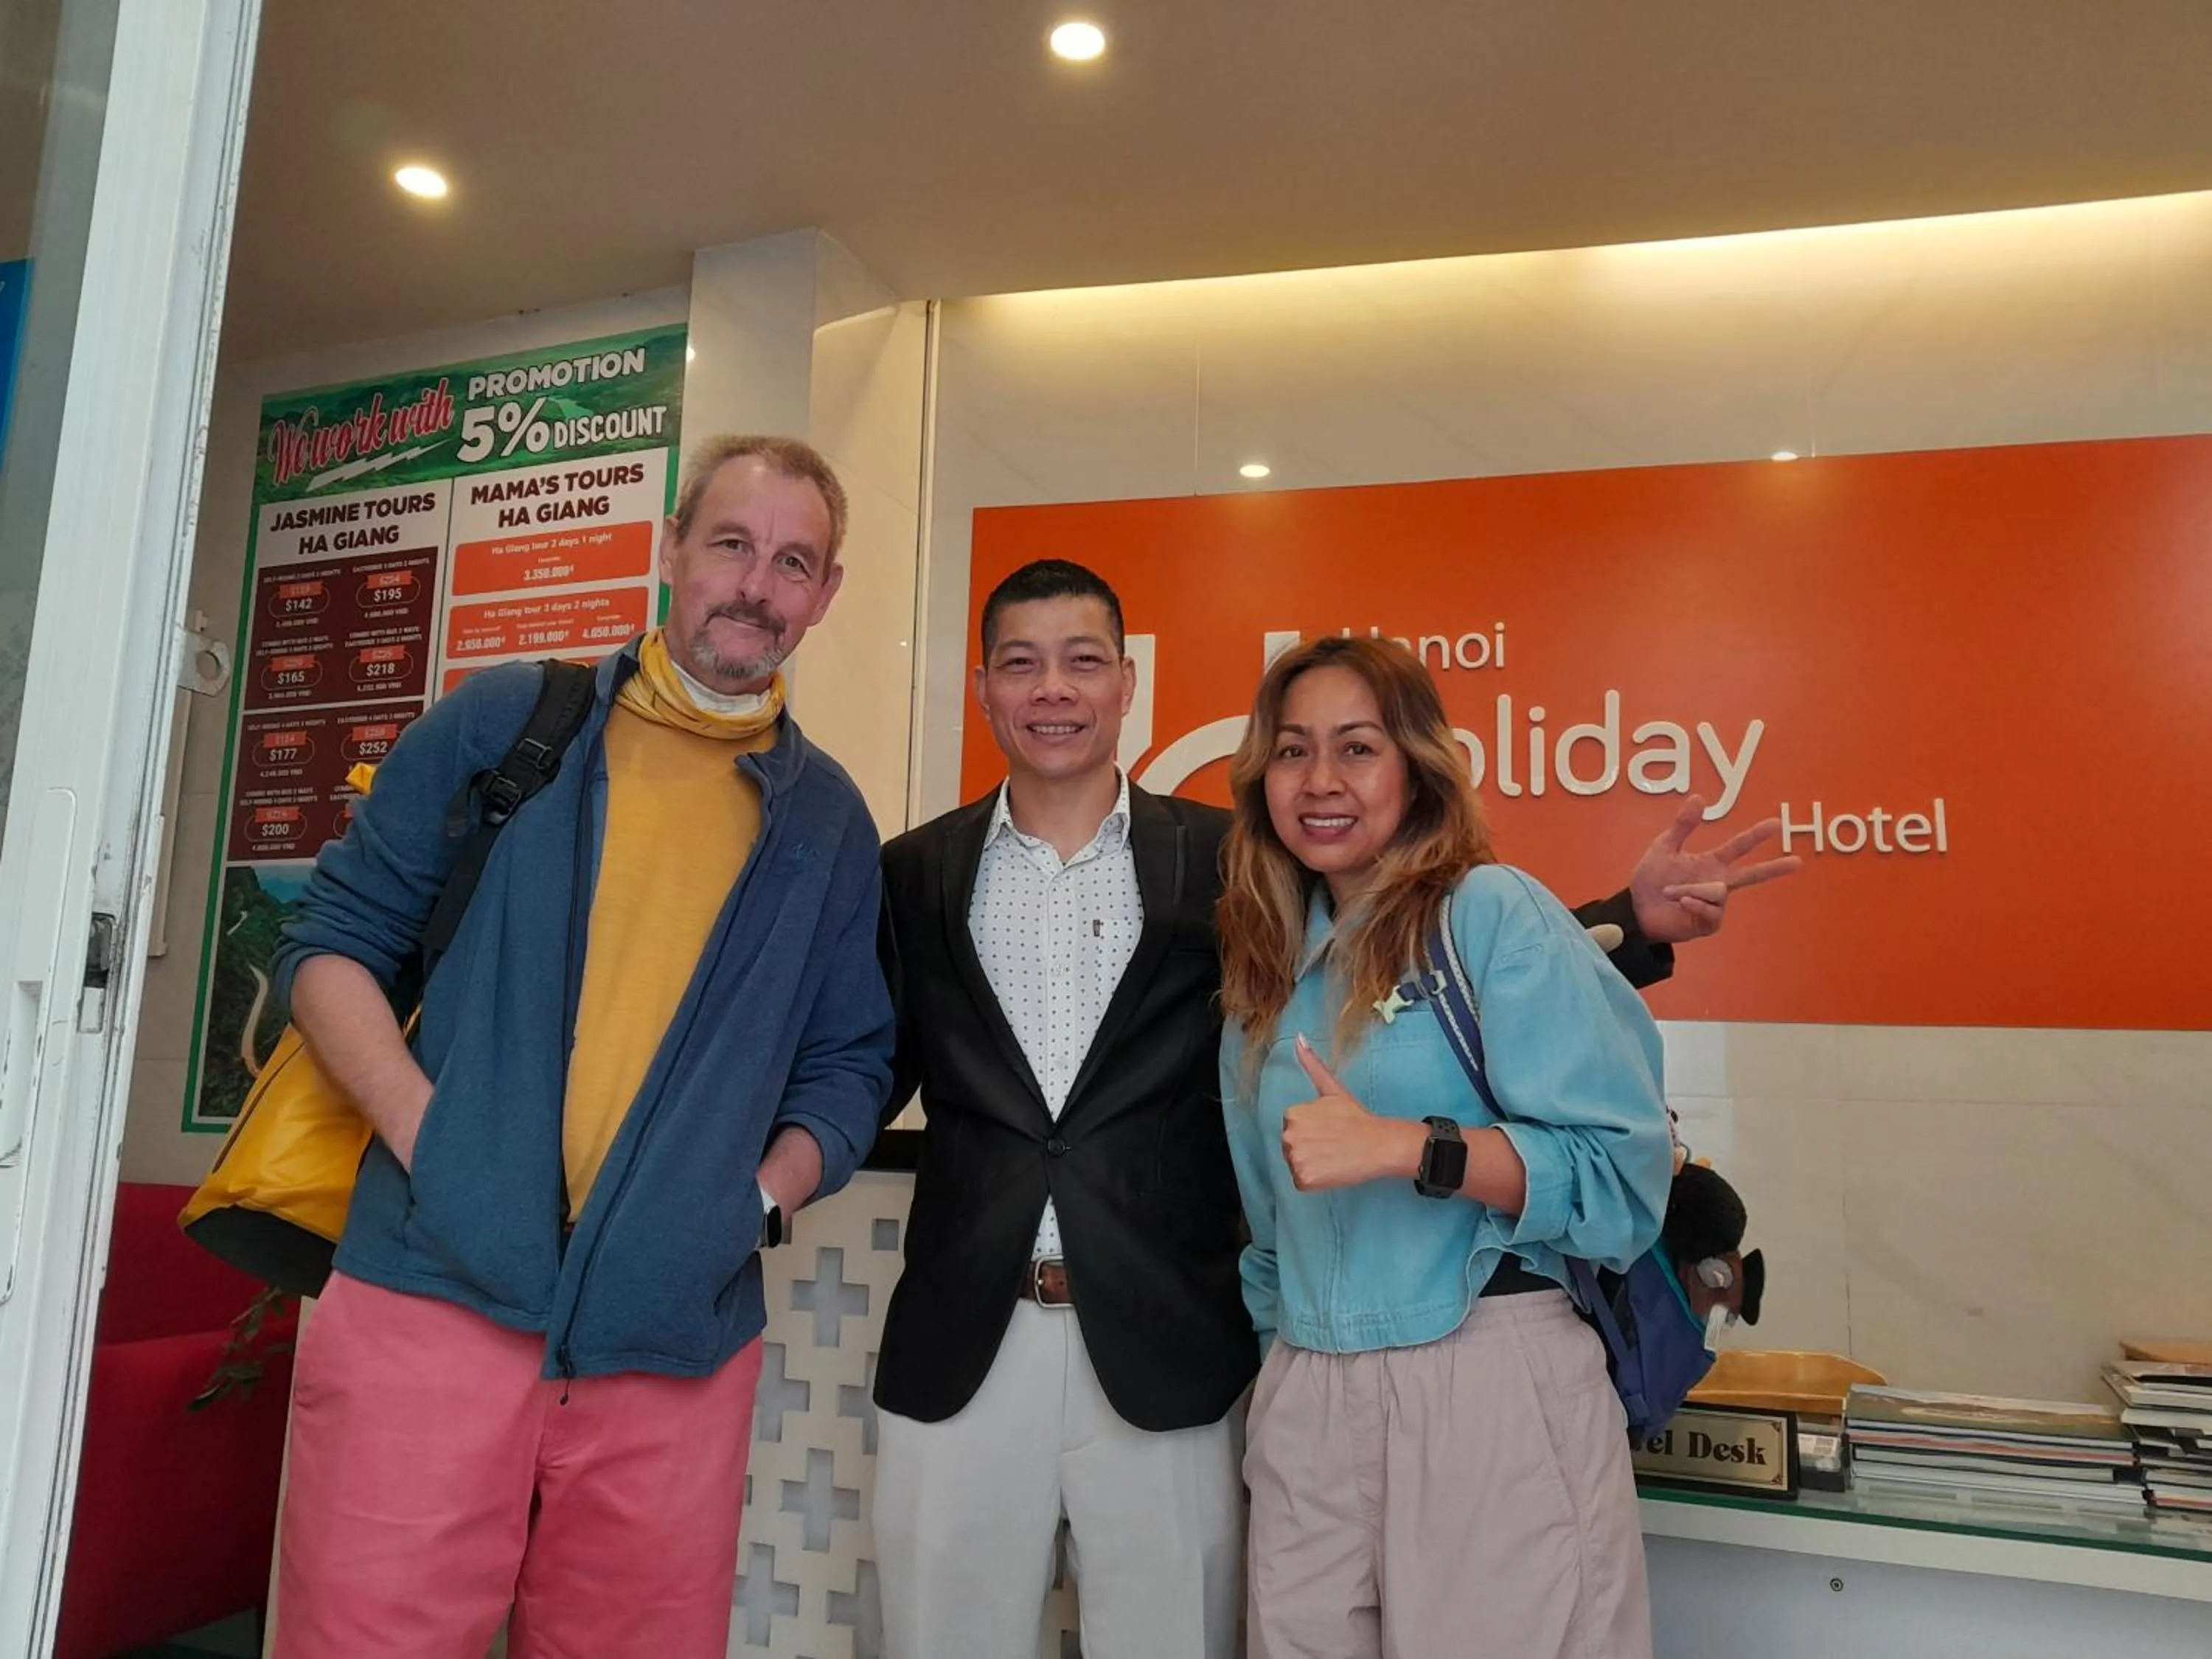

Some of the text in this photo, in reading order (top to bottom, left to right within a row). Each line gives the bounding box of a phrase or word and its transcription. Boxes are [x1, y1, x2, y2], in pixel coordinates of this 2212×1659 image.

[468, 348, 646, 401] PROMOTION
[309, 392, 387, 471] work
[389, 377, 455, 445] with
[456, 396, 667, 463] 5% DISCOUNT
[470, 463, 644, 505] MAMA'S TOURS
[270, 492, 436, 532] JASMINE TOURS
[498, 495, 610, 528] HA GIANG
[299, 525, 400, 554] HA GIANG
[285, 597, 313, 612] $142
[374, 588, 402, 602] $195
[366, 662, 395, 677] $218
[269, 748, 298, 762] $177
[359, 742, 388, 756] $252
[262, 823, 290, 837] $200
[1781, 798, 1947, 852] Hotel
[1688, 1430, 1767, 1465] Desk
